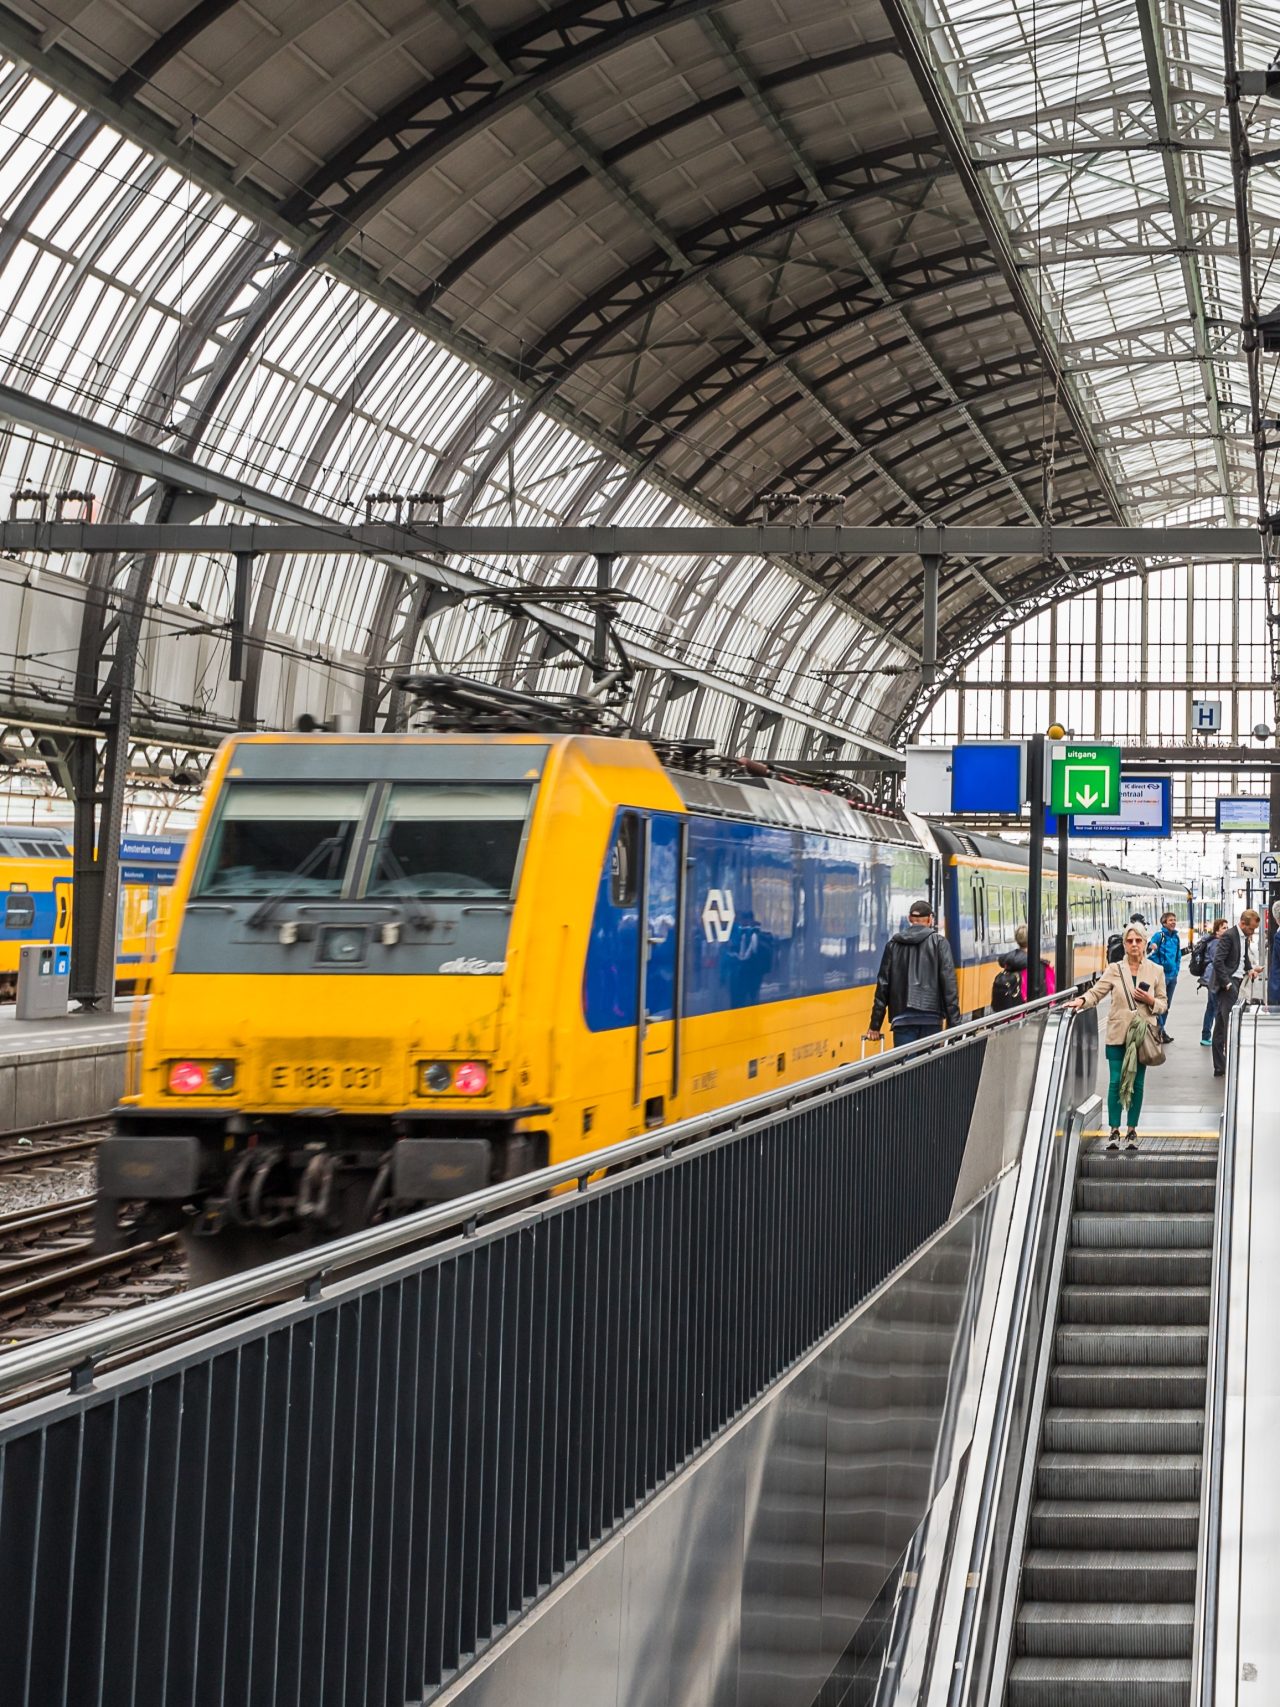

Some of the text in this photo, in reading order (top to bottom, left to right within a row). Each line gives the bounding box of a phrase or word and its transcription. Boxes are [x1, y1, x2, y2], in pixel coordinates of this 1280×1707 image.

[1198, 708, 1214, 726] H
[1067, 751, 1097, 759] uitgang
[1120, 790, 1143, 798] entraal
[123, 844, 171, 855] Amsterdam Centraal
[271, 1066, 289, 1088] E
[294, 1066, 335, 1088] 186
